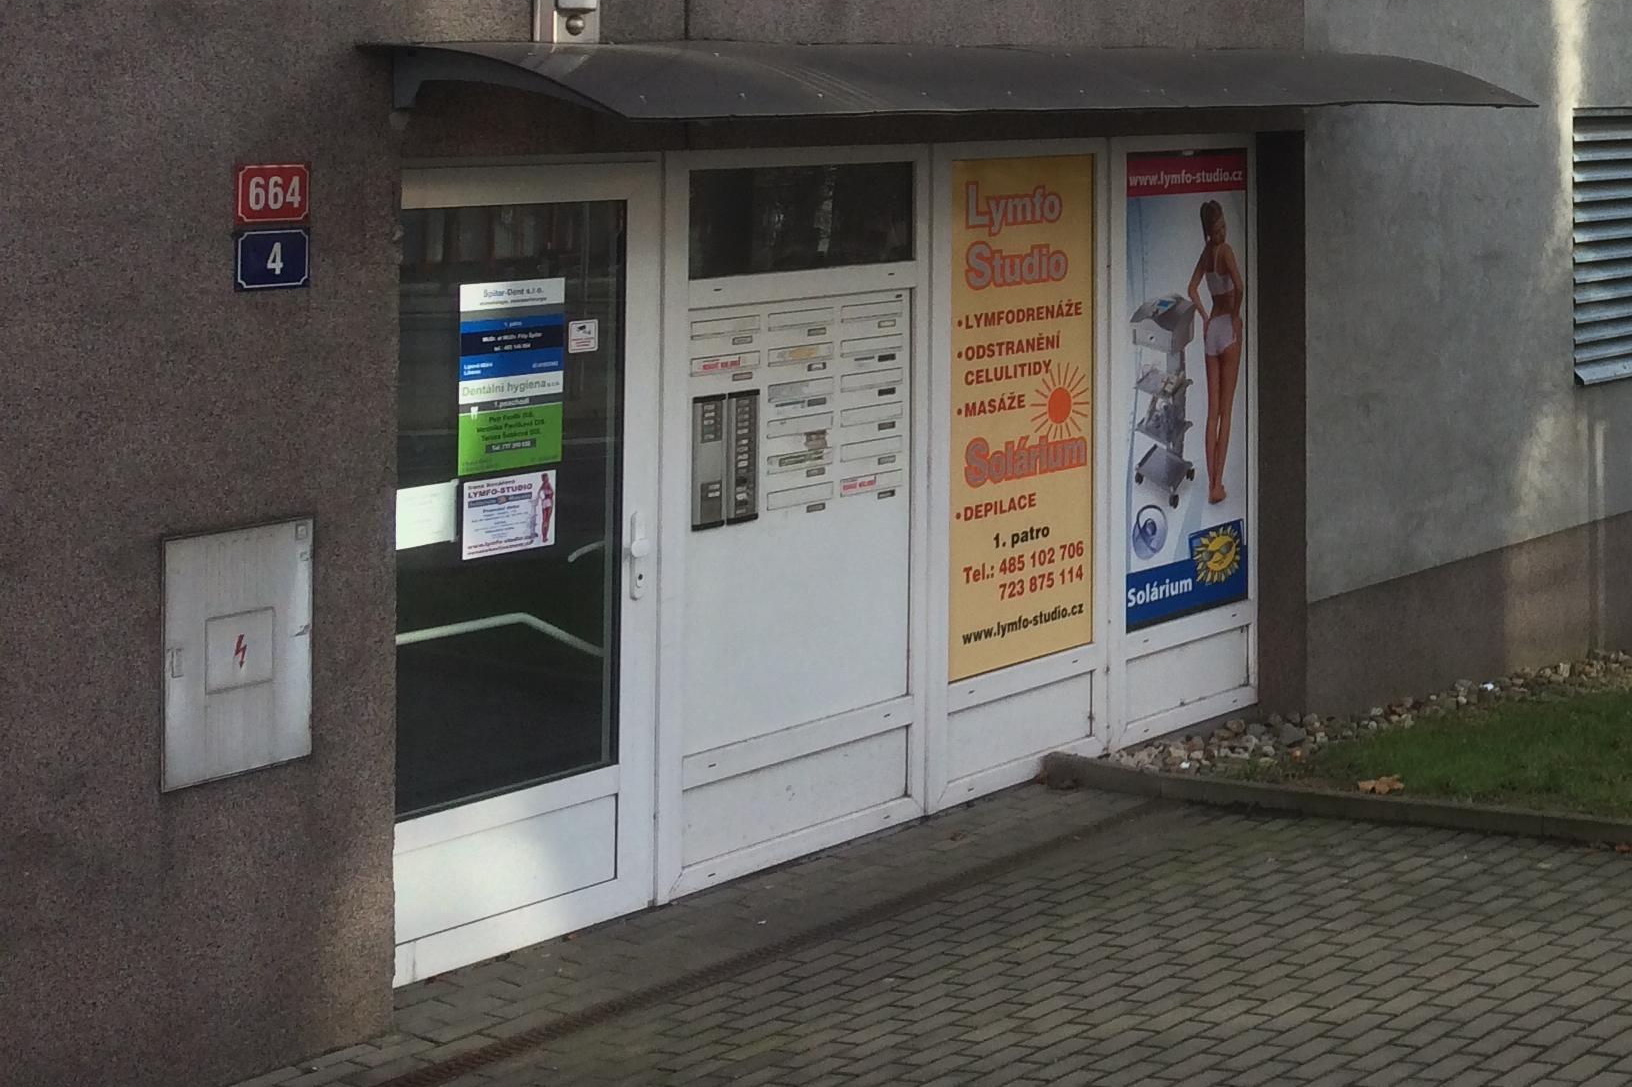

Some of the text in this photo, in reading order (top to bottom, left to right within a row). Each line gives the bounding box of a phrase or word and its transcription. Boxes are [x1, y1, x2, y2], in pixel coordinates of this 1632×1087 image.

[249, 175, 302, 211] 664
[1129, 167, 1243, 189] www.lymfo-studio.cz
[965, 181, 1063, 236] Lymfo
[266, 241, 284, 275] 4
[965, 240, 1069, 291] Studio
[964, 299, 1083, 330] LYMFODRENÁŽE
[964, 330, 1062, 362] ODSTRANĚNÍ
[507, 379, 547, 394] hygiena
[964, 359, 1053, 386] CELULITIDY
[964, 392, 1026, 418] MASÁŽE
[964, 435, 1088, 489] Solárium
[963, 492, 1038, 522] DEPILACE
[993, 525, 1050, 549] 1. patro
[963, 540, 1084, 585] Tel.: 485 102 706
[999, 564, 1084, 602] 723 875 114
[1127, 575, 1193, 608] Solárium
[962, 601, 1084, 646] www.lymfo-studio.cz
